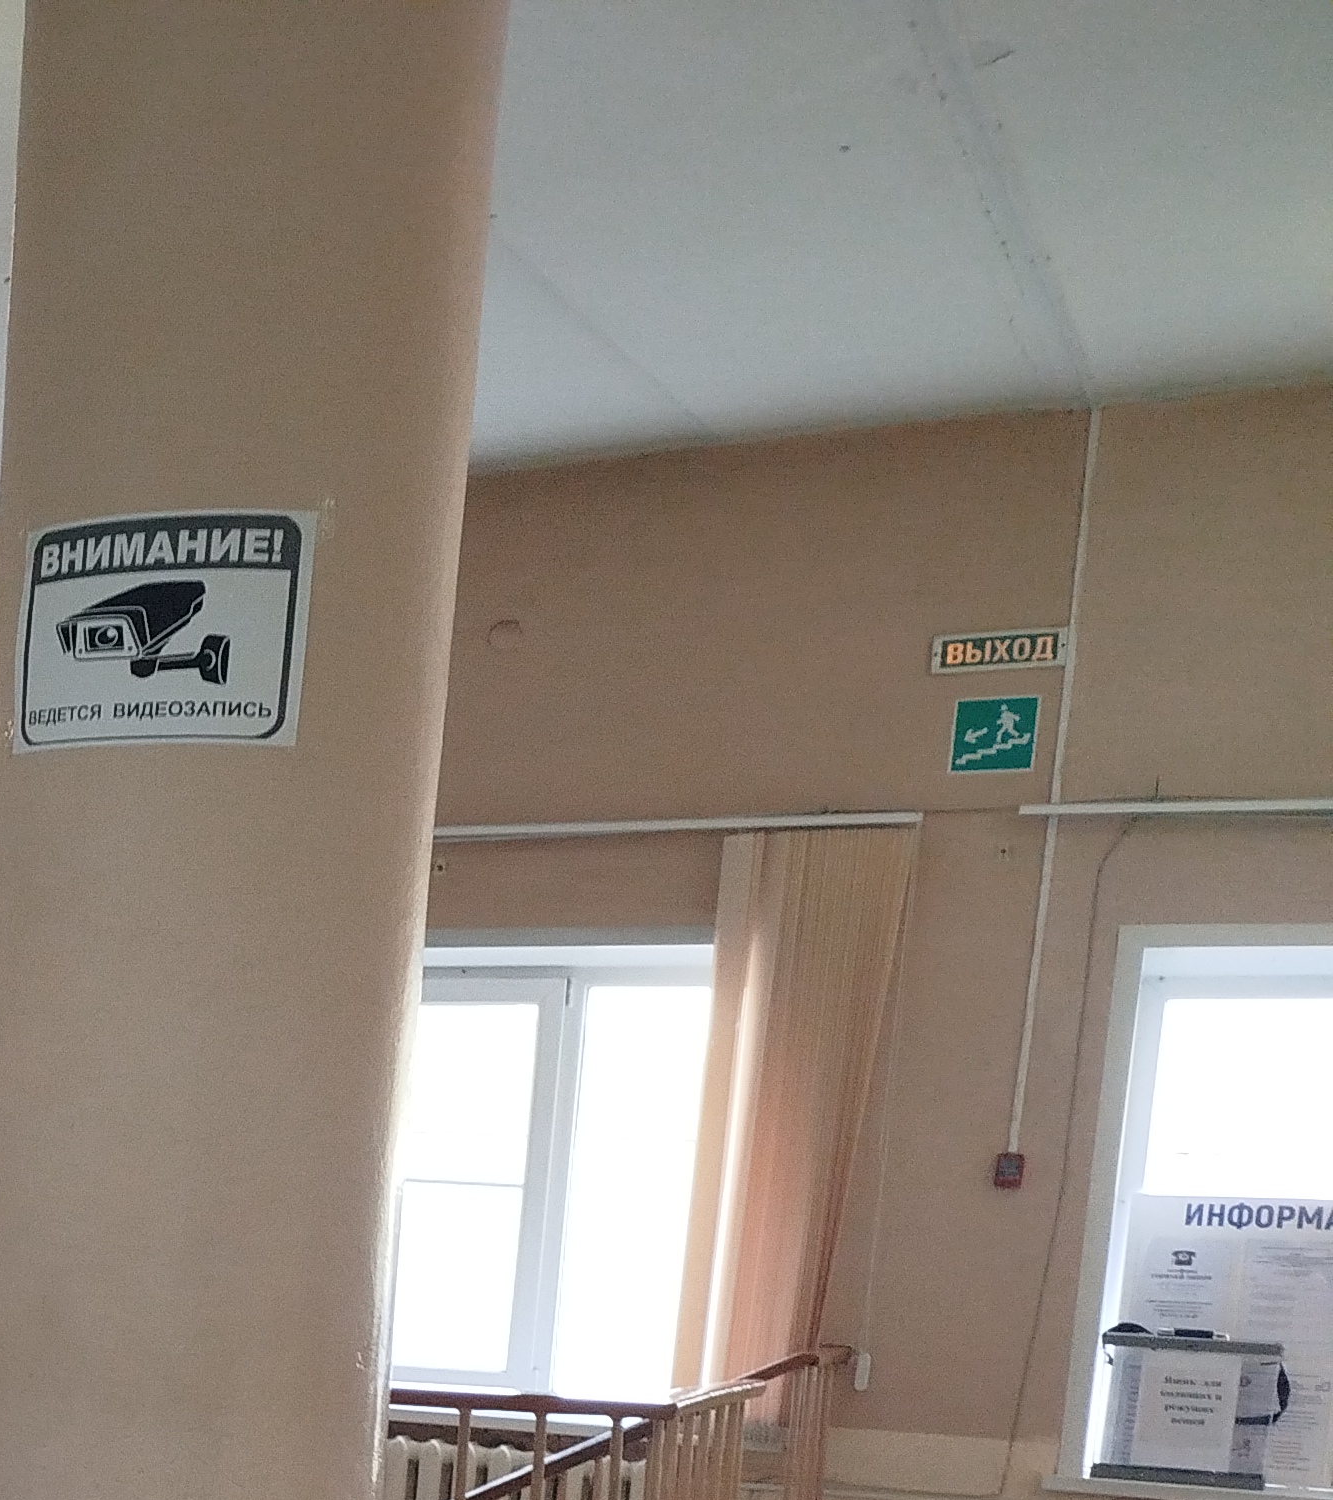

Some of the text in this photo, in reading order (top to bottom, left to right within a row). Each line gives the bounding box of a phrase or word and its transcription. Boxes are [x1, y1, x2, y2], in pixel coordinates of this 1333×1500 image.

[39, 527, 285, 578] ВНИМАНИЕ!
[946, 636, 1054, 665] ВЫХОД
[28, 700, 273, 726] ВЕДЕТСЯ ВИДЕОЗАПИСЬ
